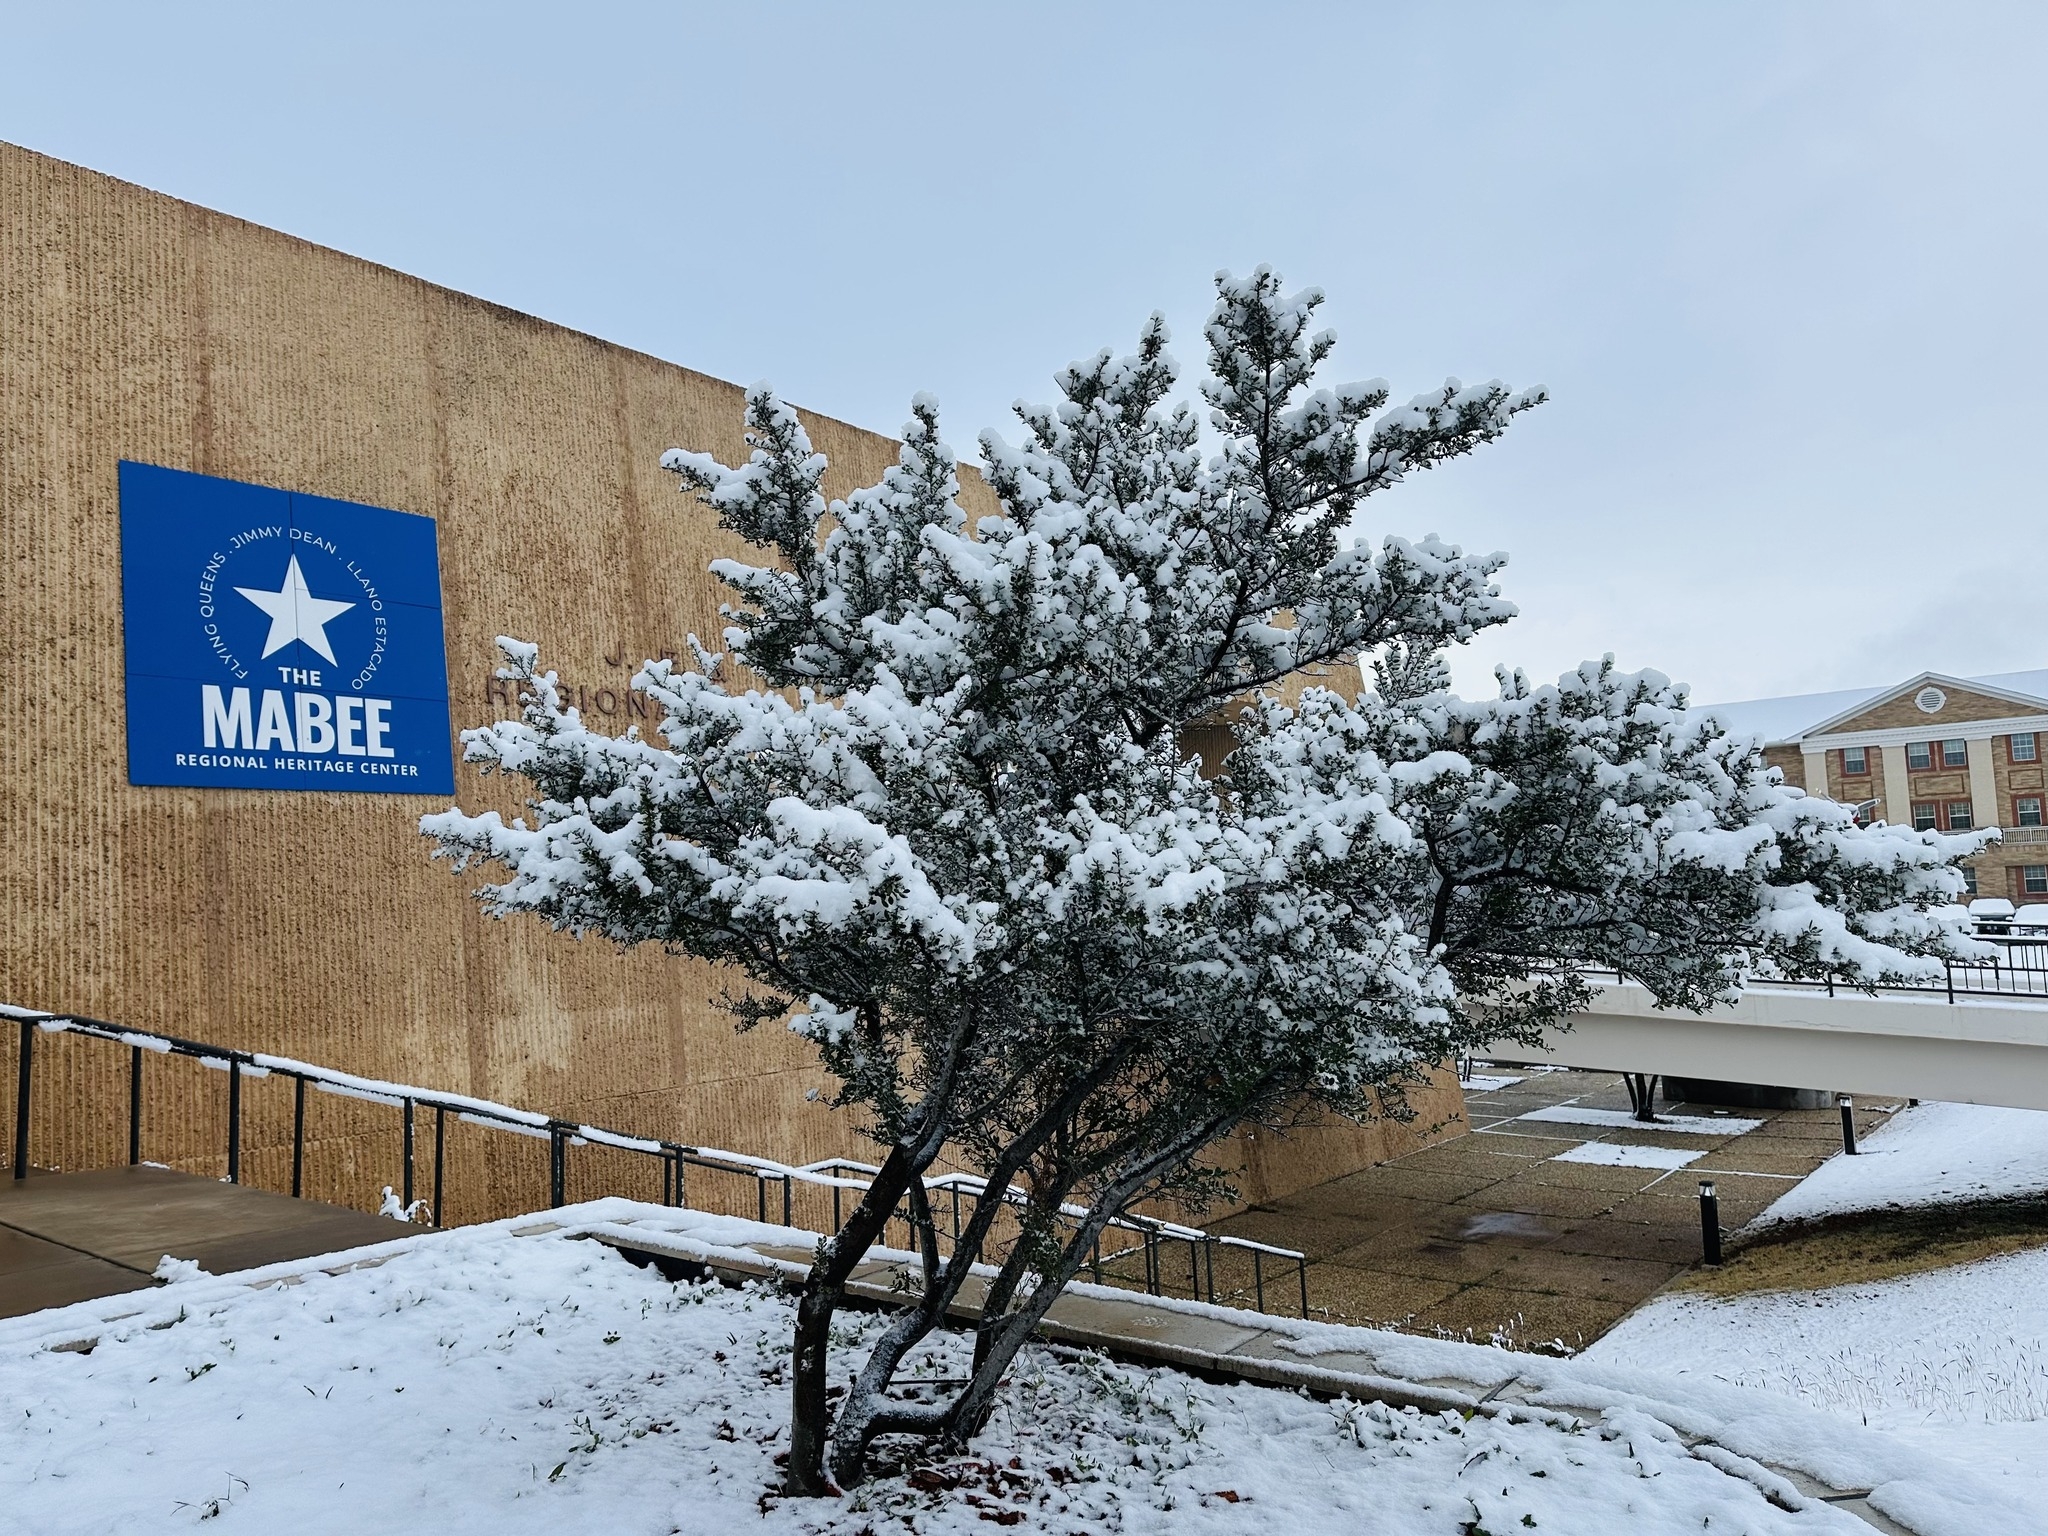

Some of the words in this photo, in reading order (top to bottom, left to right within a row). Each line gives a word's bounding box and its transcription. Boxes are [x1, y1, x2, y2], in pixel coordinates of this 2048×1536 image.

[230, 526, 282, 549] JIMMY
[289, 528, 337, 555] DEAN
[199, 552, 227, 618] QUEENS
[346, 560, 383, 611] LLANO
[204, 623, 248, 680] FLYING
[278, 667, 322, 687] THE
[351, 617, 387, 690] ESTACADO
[202, 684, 395, 758] MABEE
[176, 753, 268, 769] REGIONAL
[274, 757, 354, 773] HERITAGE
[360, 762, 419, 777] CENTER
